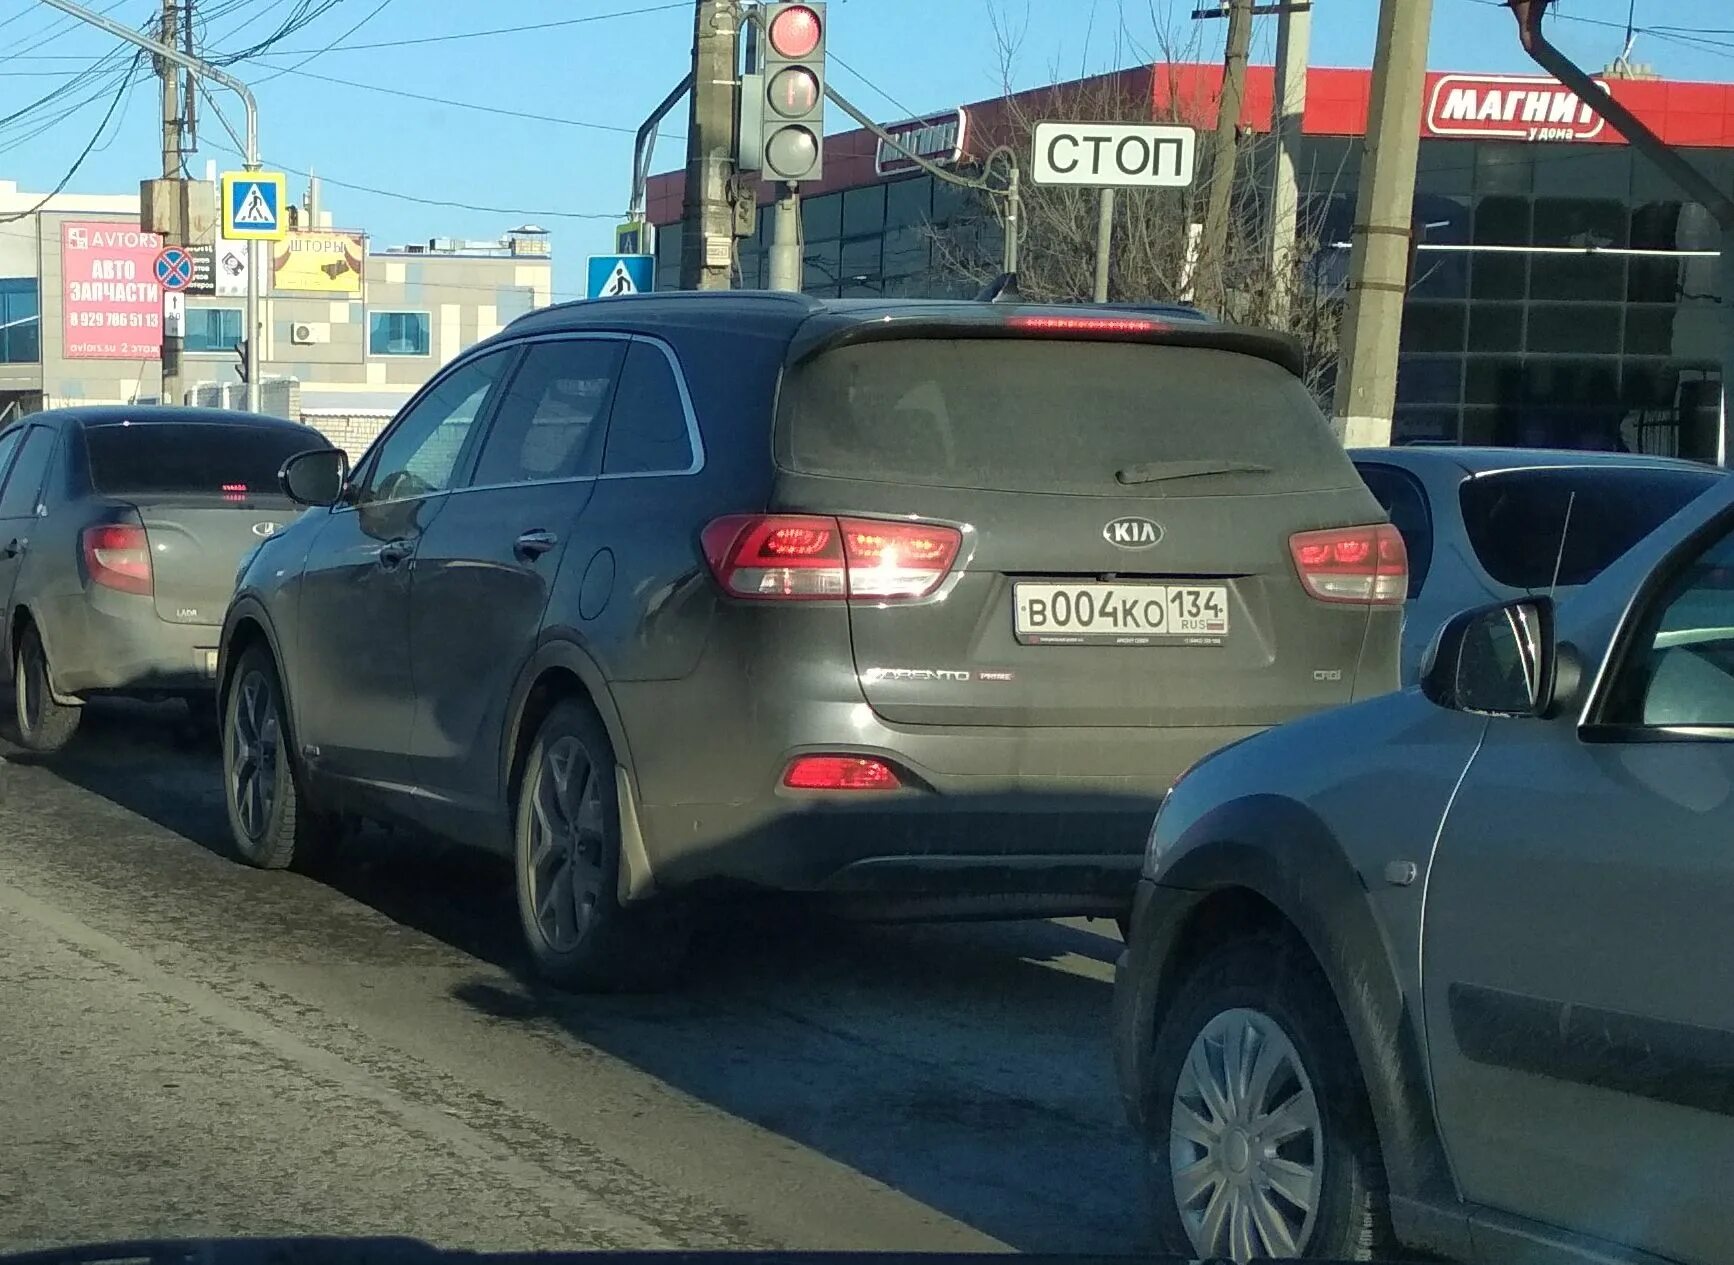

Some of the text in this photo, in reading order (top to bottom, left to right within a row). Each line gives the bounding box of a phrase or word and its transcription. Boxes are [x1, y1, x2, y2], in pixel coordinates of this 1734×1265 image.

[1528, 127, 1574, 141] у дома
[1047, 133, 1184, 176] СТОП
[91, 231, 158, 248] AVTORS
[290, 239, 344, 253] ШТОРЫ
[91, 259, 136, 280] АВТО
[69, 281, 158, 302] ЗАПЧАСТИ
[70, 312, 78, 327] 8
[80, 312, 104, 327] 929
[129, 313, 143, 327] 51
[145, 313, 159, 328] 13
[121, 343, 129, 353] 2
[131, 344, 160, 353] этаж
[1114, 522, 1156, 541] KIA
[1170, 590, 1219, 618] 134
[1181, 619, 1206, 630] RUS
